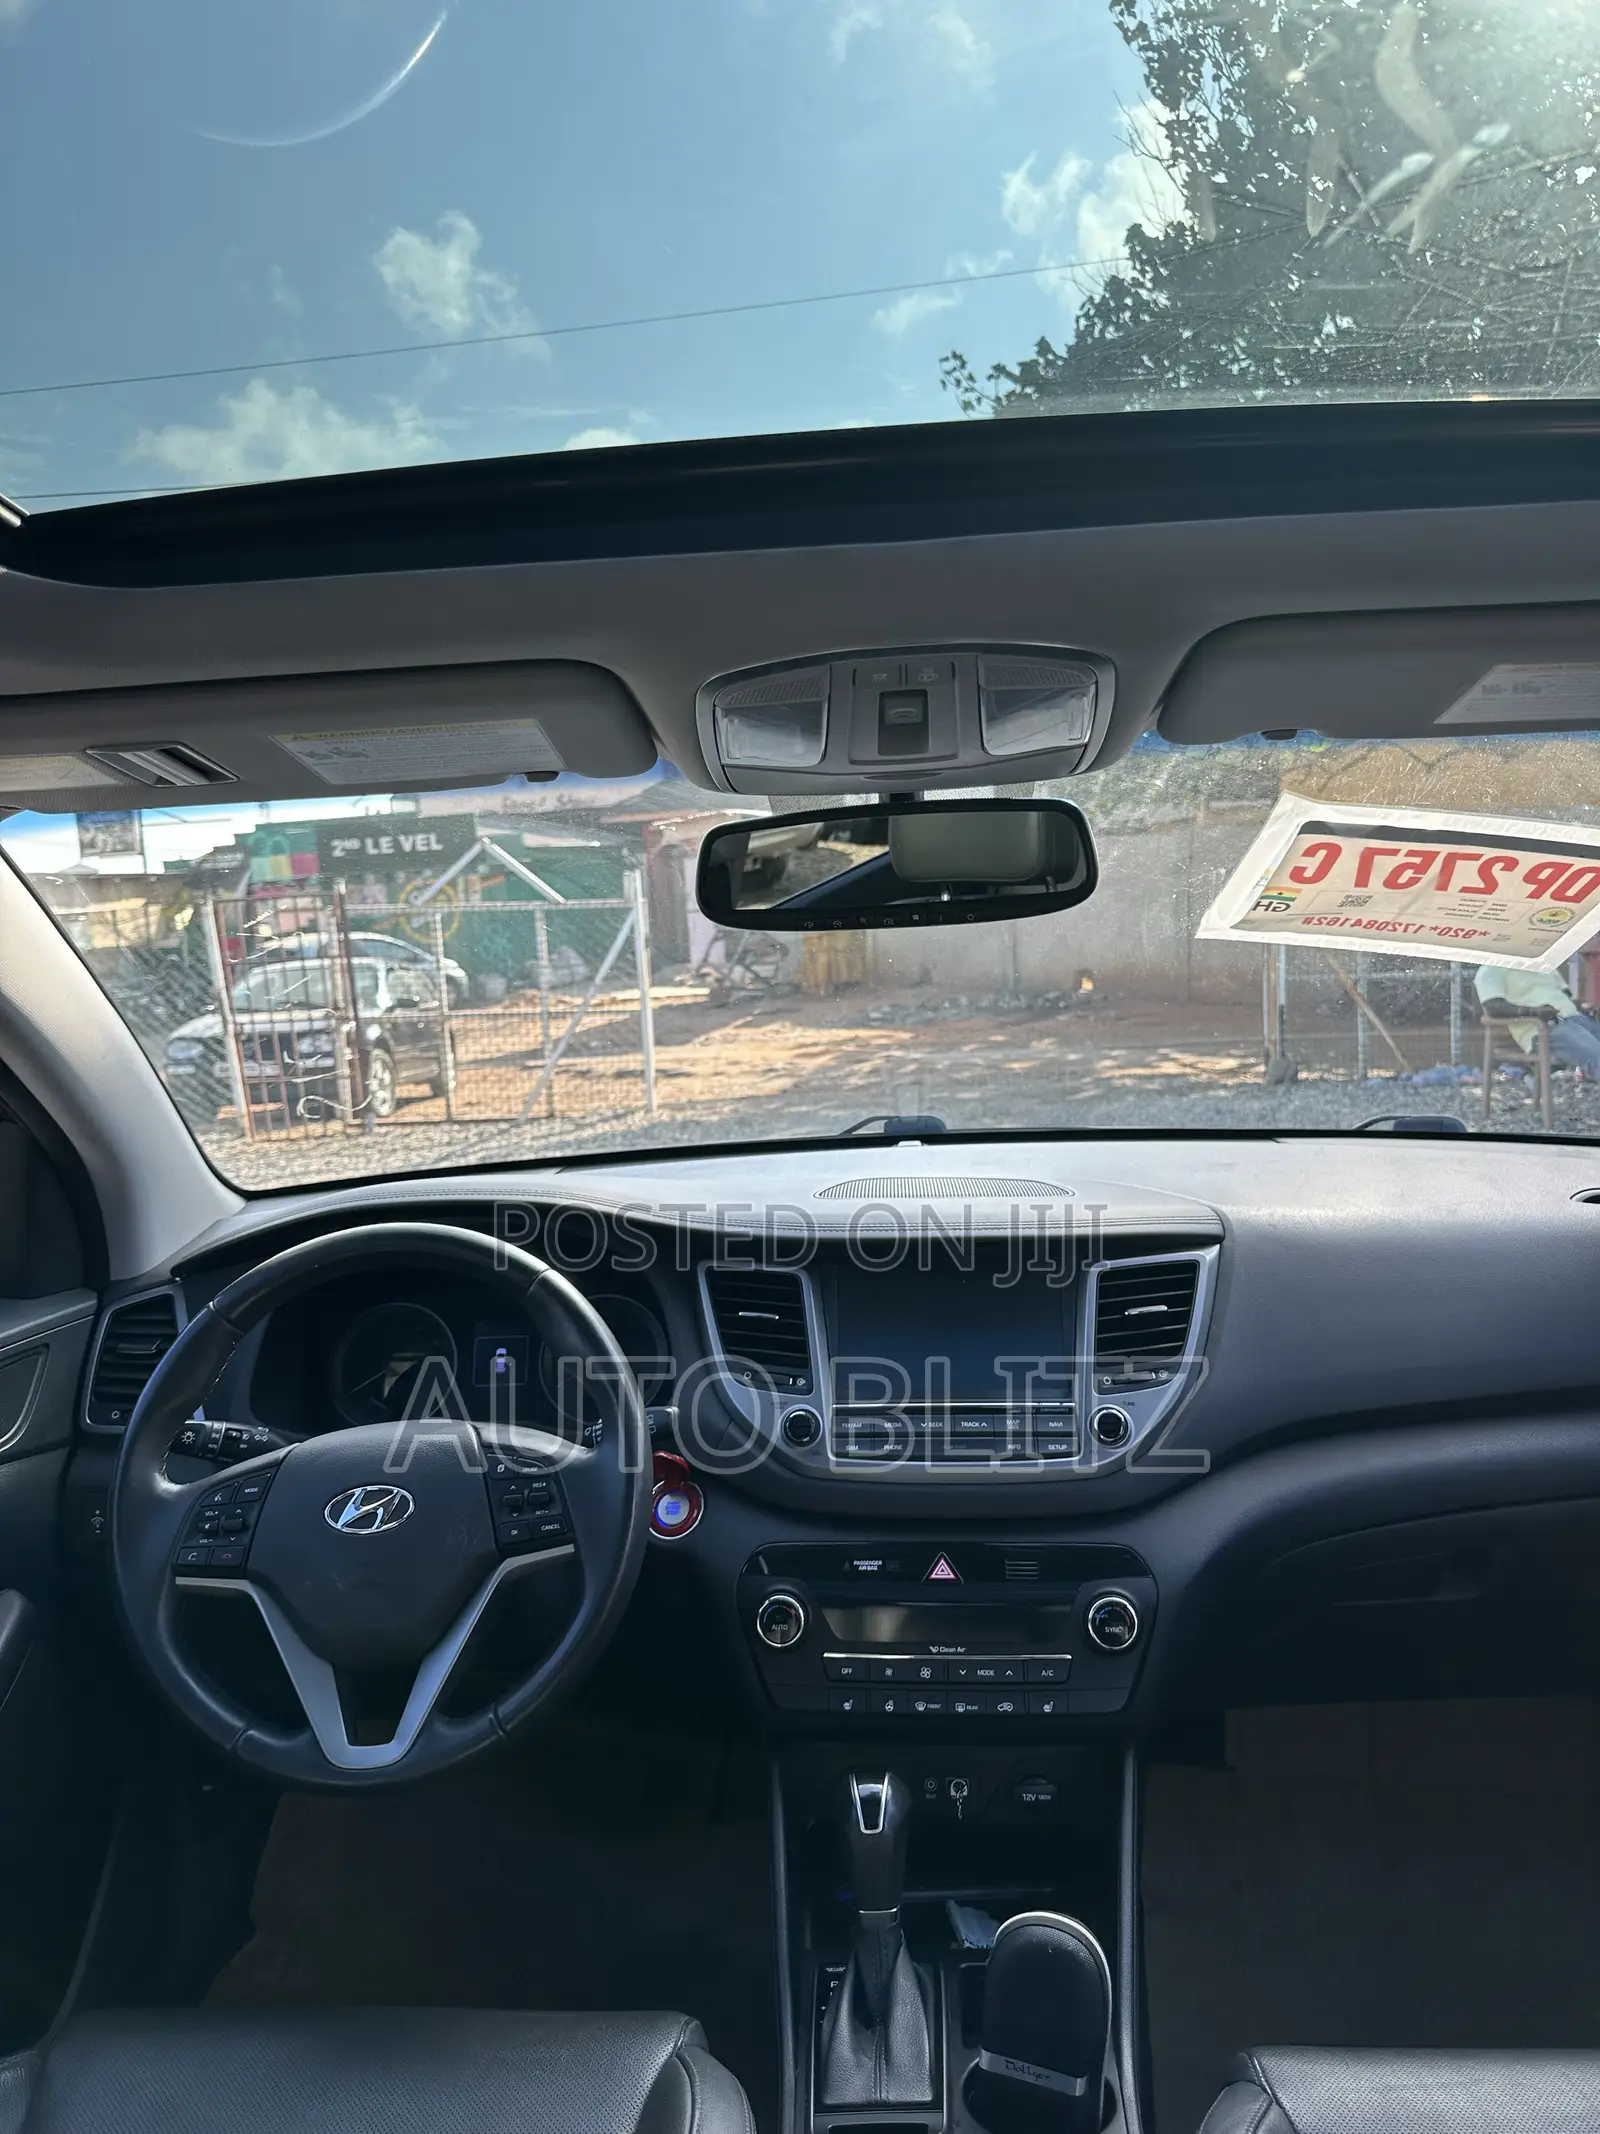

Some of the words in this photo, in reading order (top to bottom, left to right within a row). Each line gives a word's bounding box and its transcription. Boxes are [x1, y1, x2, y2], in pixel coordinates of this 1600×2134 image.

[541, 1523, 561, 1531] CANCEL
[841, 1667, 853, 1675] OFF
[1041, 1669, 1054, 1677] A/C
[1022, 1793, 1036, 1801] 12V
